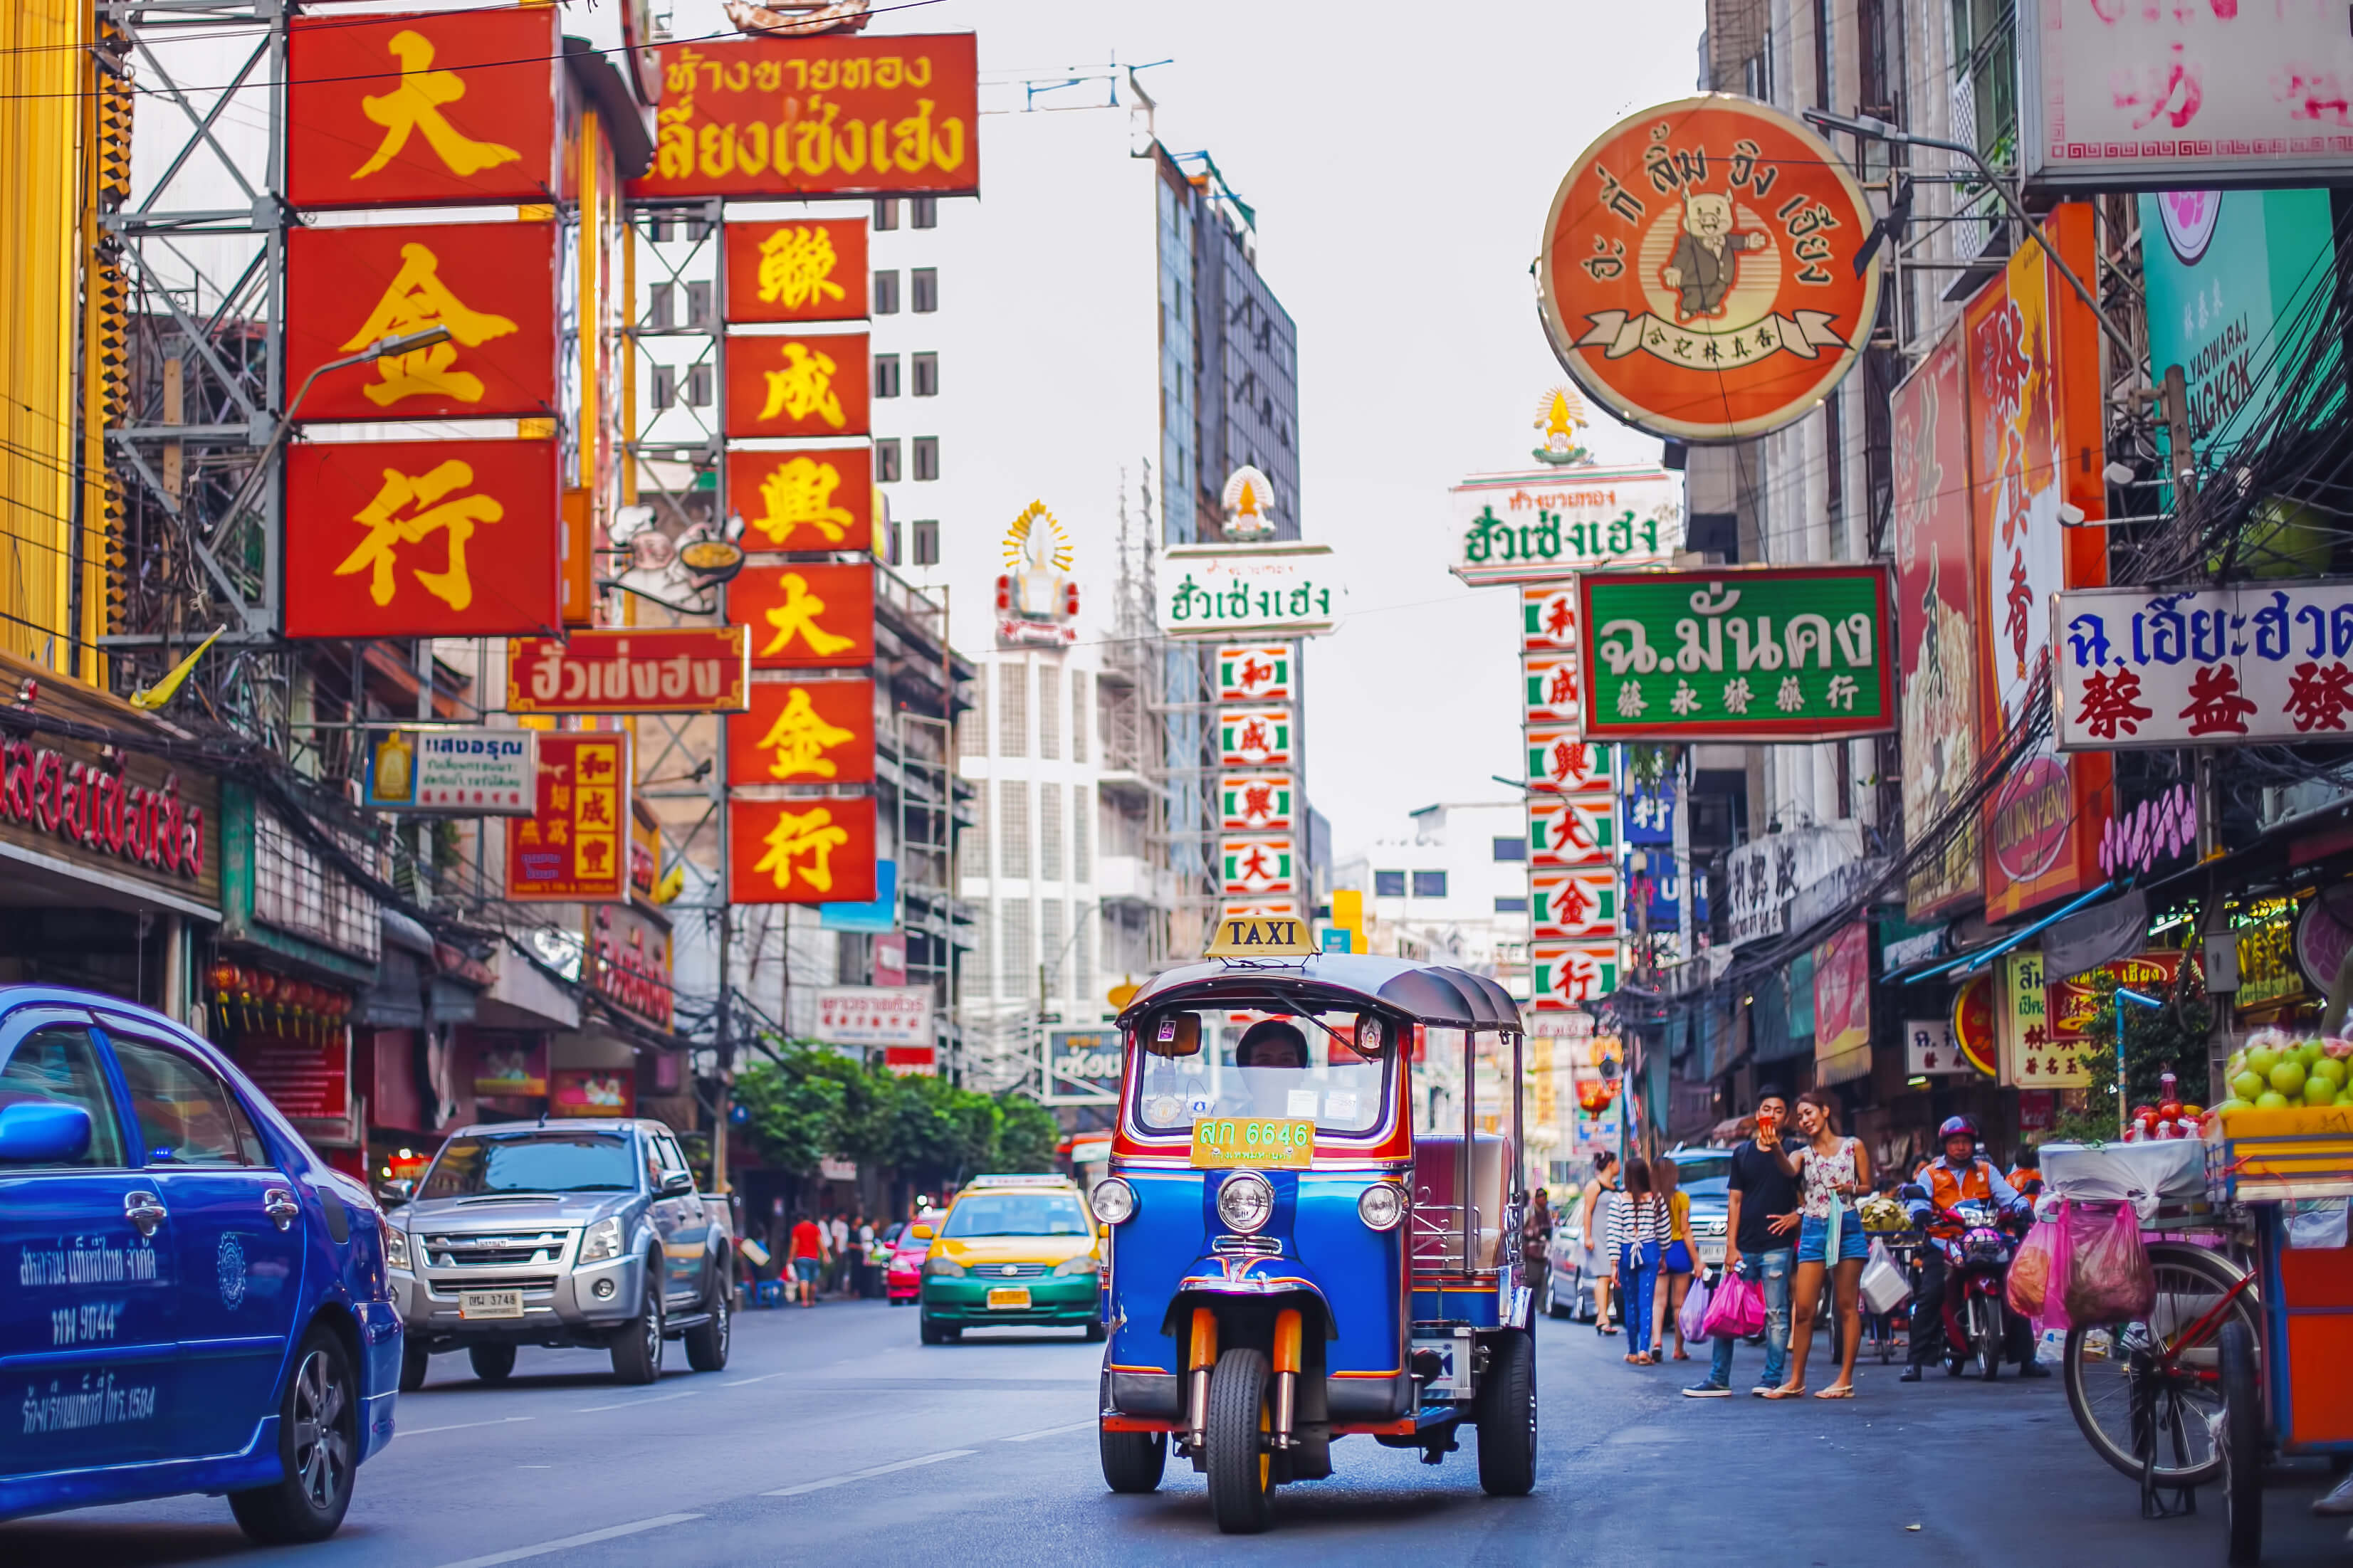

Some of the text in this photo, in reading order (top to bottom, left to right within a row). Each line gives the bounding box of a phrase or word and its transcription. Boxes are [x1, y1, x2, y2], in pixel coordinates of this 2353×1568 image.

[666, 48, 931, 93] ห้างขายทอง
[643, 94, 965, 180] ลี่ยงเซ่งเฮง
[2190, 312, 2248, 383] YAOWARAJ
[2191, 347, 2253, 440] NGKOK
[1600, 582, 1872, 675] ฉ.มั่นคง
[426, 738, 523, 760] แสงอรุณ
[1227, 922, 1296, 945] TAXI
[1200, 1122, 1308, 1147] สก 6646
[80, 1304, 114, 1340] 9044
